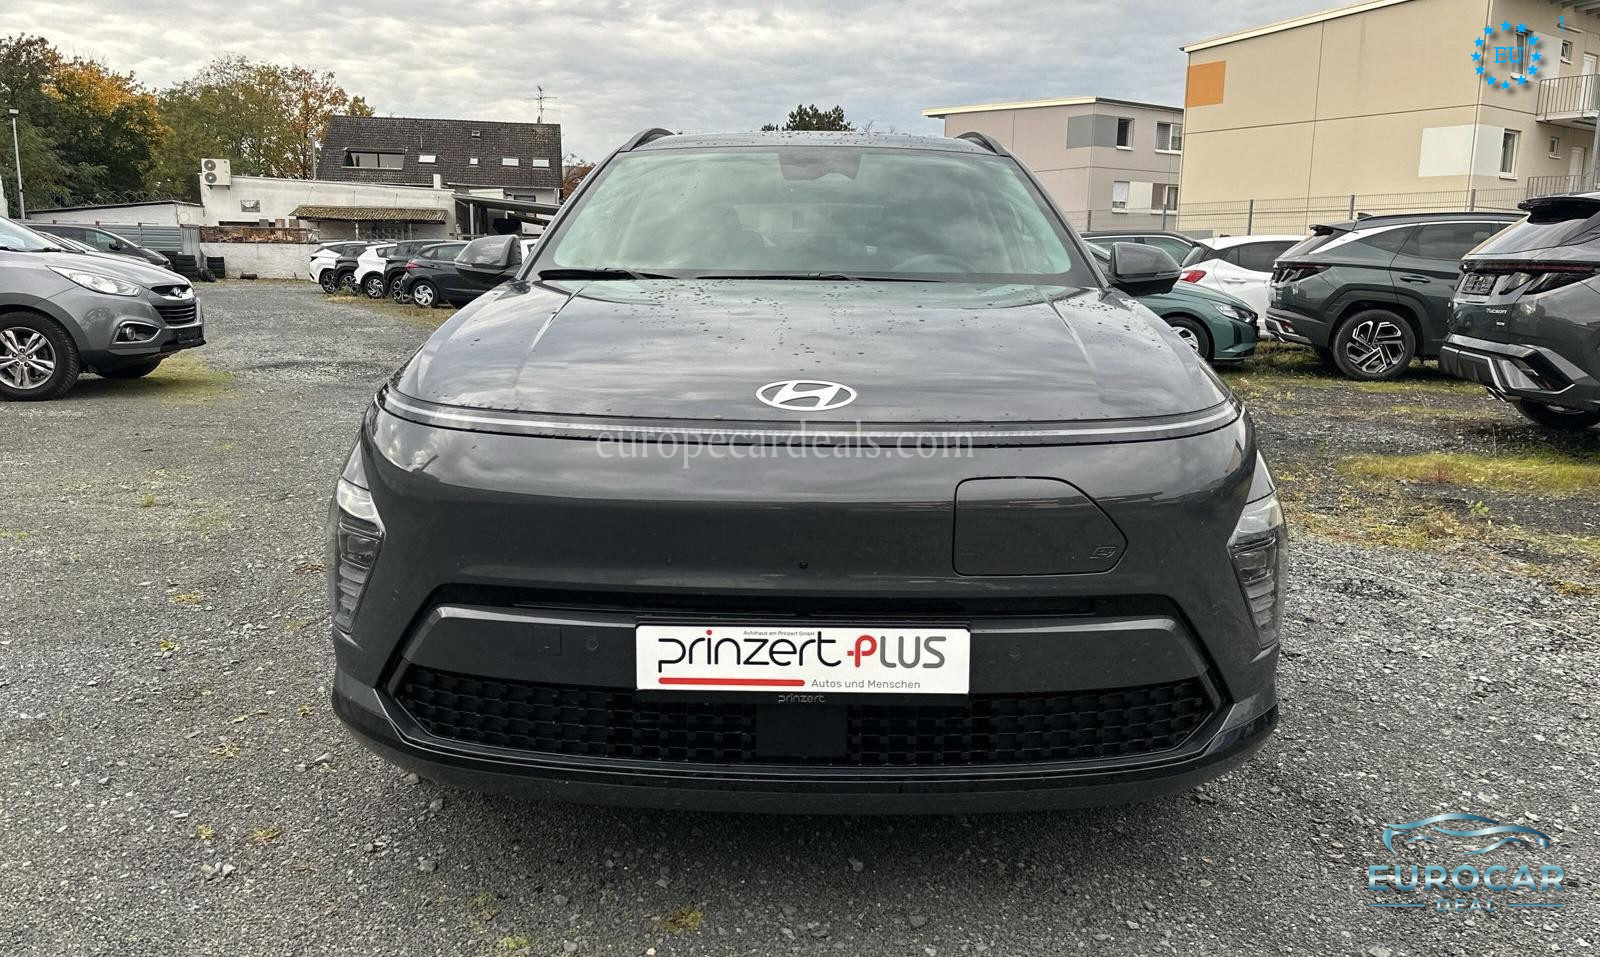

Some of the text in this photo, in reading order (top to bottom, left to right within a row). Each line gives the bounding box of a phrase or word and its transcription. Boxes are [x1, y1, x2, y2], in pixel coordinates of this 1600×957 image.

[658, 629, 842, 673] prinzert
[811, 679, 921, 689] Autos und Menschen
[777, 693, 826, 704] prinzert
